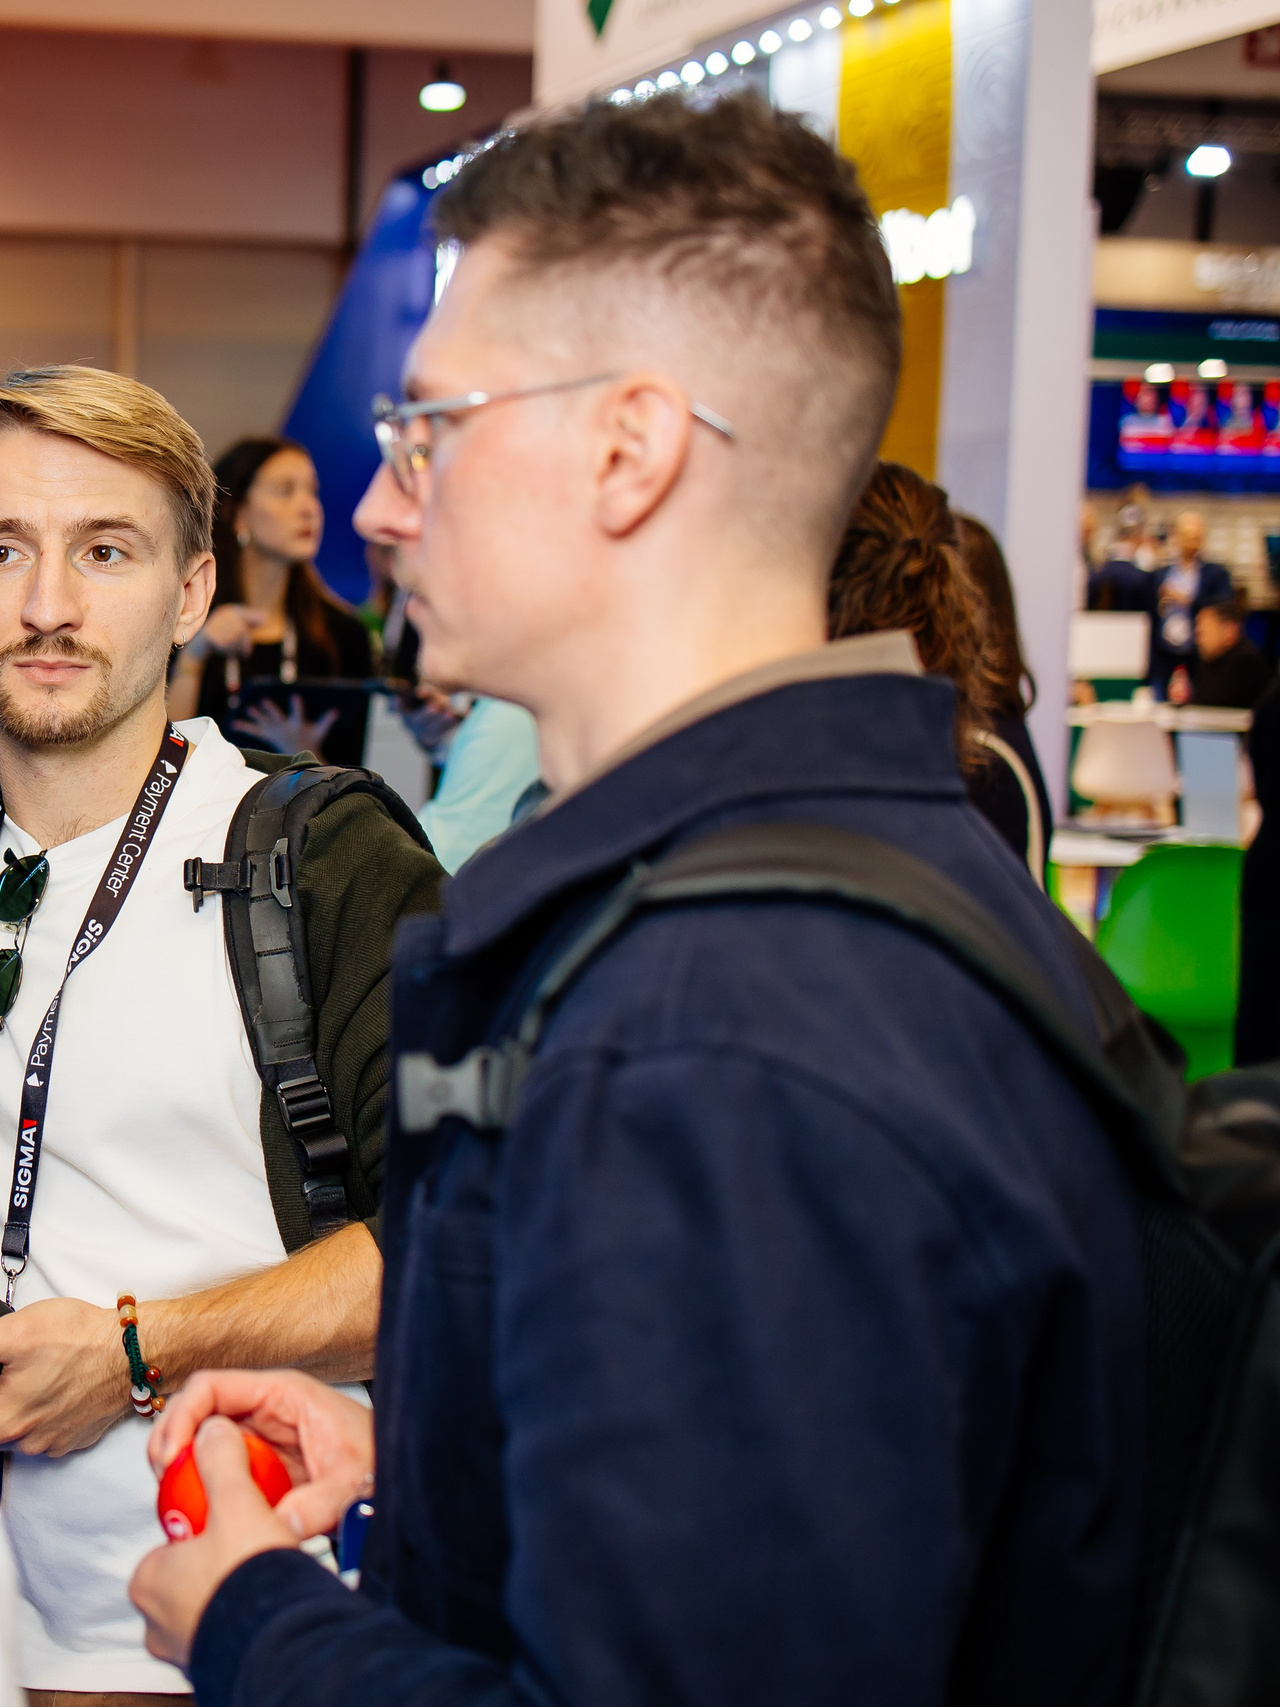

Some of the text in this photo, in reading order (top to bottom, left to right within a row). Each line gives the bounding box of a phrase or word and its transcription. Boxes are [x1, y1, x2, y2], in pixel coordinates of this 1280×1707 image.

[106, 773, 173, 899] Payment Center
[67, 919, 103, 975] SiGM
[30, 995, 60, 1065] Payme
[13, 1127, 37, 1208] SiGMA
